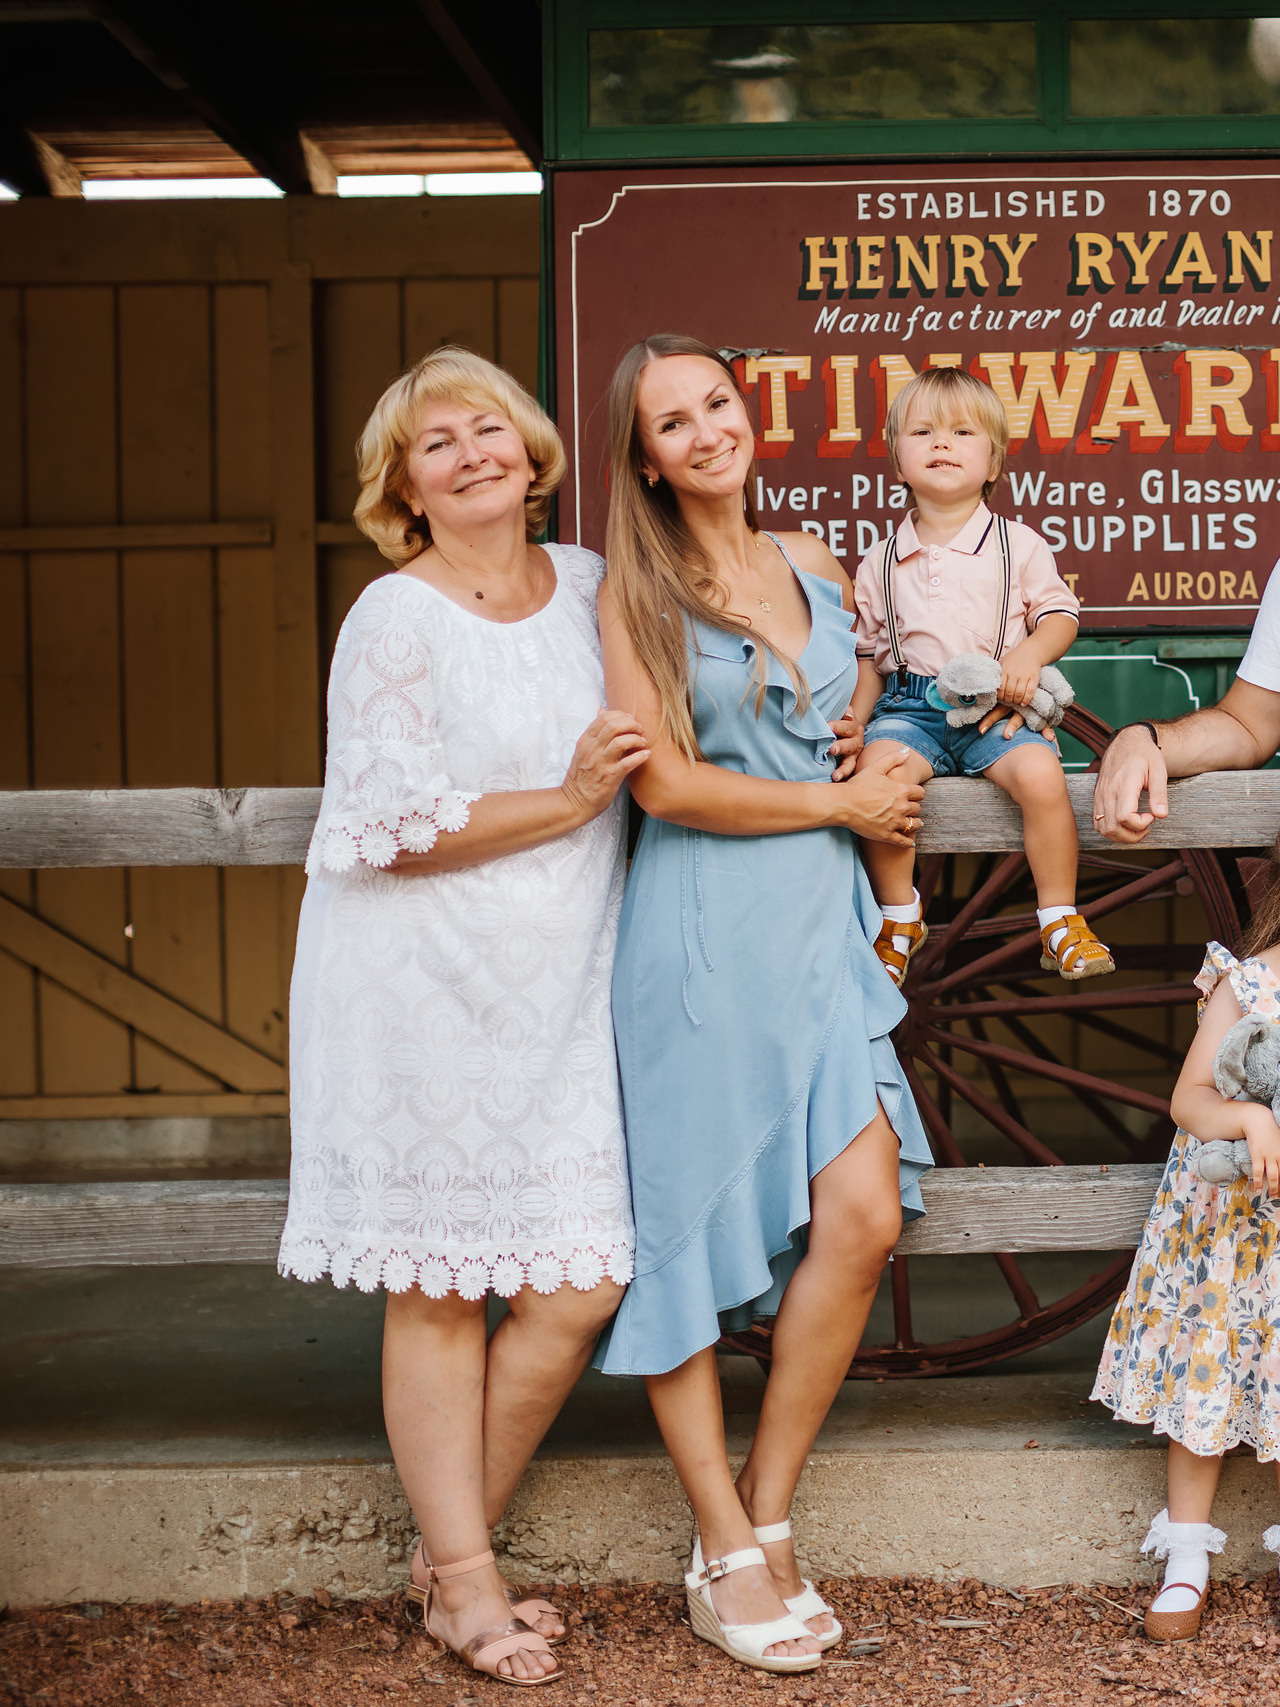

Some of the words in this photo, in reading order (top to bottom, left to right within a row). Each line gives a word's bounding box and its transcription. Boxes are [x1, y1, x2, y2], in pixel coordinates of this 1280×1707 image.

[857, 190, 1105, 220] ESTABLISHED
[1148, 189, 1231, 217] 1870
[801, 232, 1038, 296] HENRY
[1070, 230, 1273, 292] RYAN
[813, 303, 1062, 341] Manufacturer
[1069, 301, 1103, 340] of
[1108, 300, 1167, 328] and
[1178, 299, 1265, 327] Dealer
[1008, 470, 1125, 509] Ware,
[1040, 512, 1258, 553] SUPPLIES
[1126, 570, 1259, 602] AURORA
